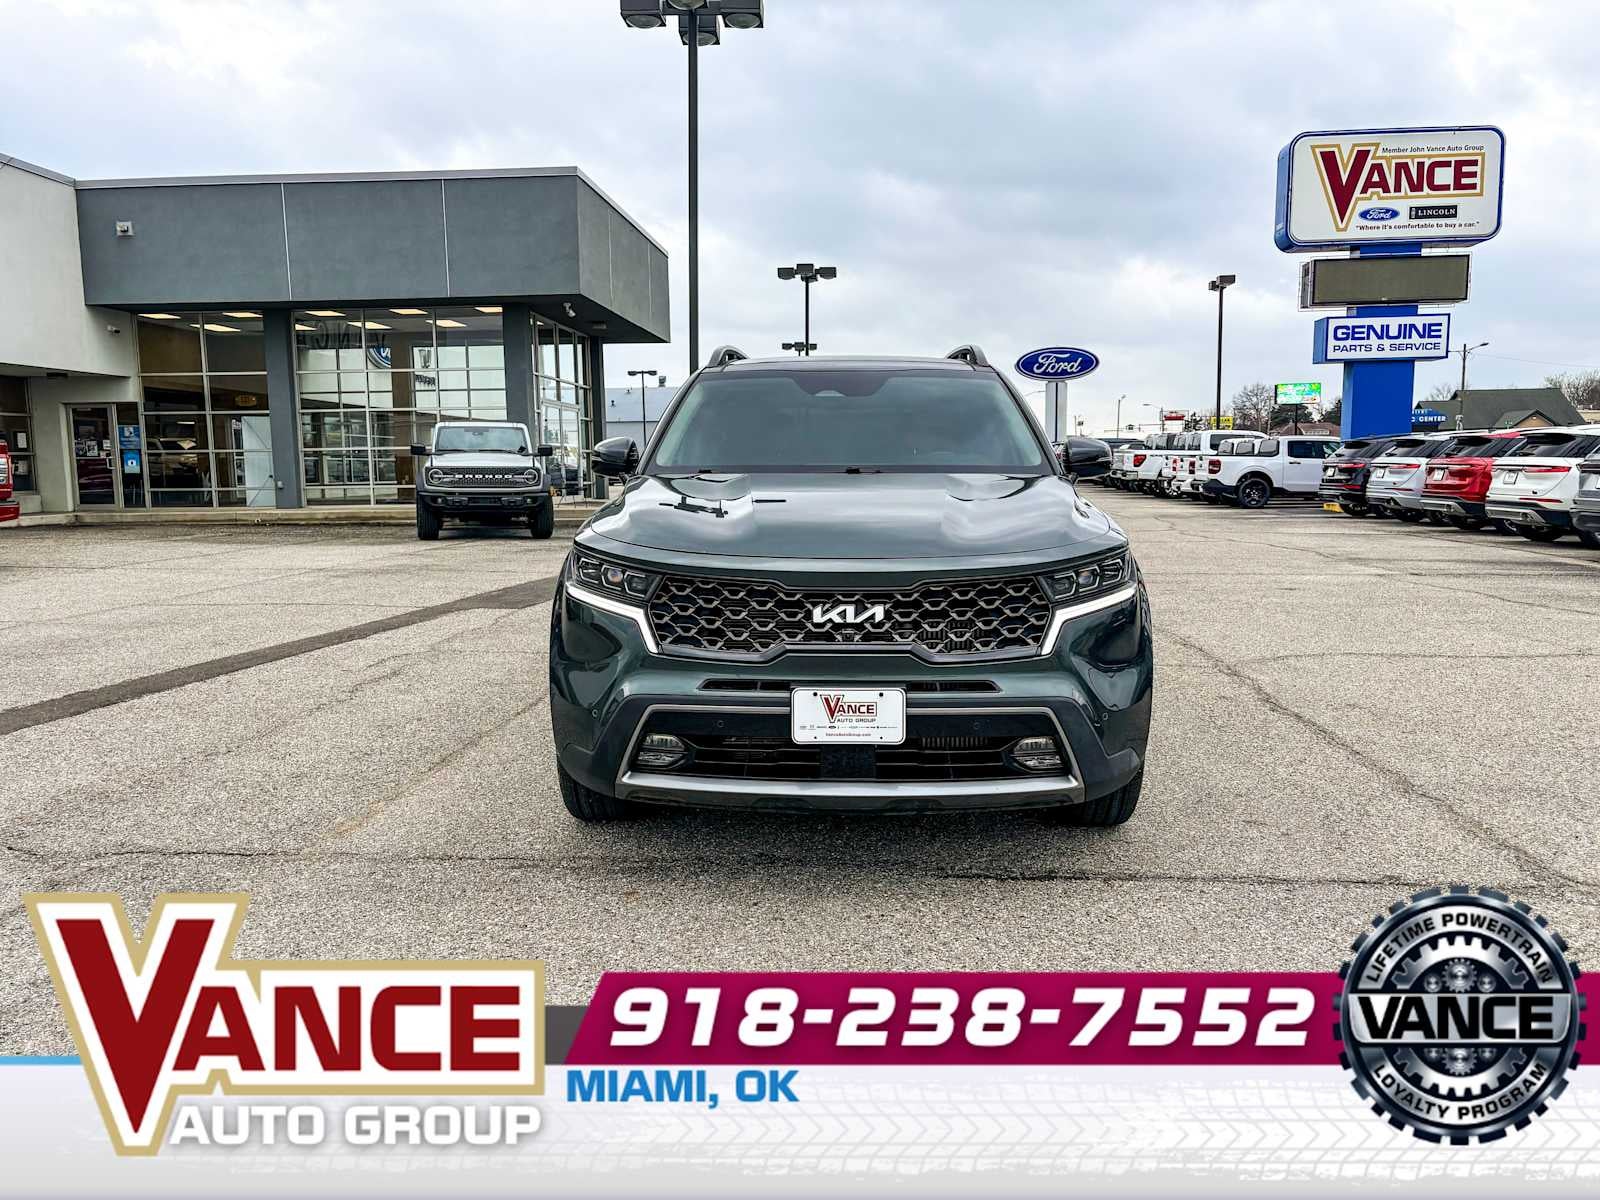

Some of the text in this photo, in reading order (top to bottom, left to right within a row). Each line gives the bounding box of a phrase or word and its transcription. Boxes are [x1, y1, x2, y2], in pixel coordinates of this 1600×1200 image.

[1410, 146, 1425, 154] John
[1464, 144, 1485, 152] Group
[1319, 149, 1479, 224] VANCE
[1366, 209, 1392, 219] Ford
[1418, 208, 1456, 216] LINCOLN
[1393, 222, 1435, 230] comfortable
[1333, 322, 1443, 341] GENUINE
[1333, 342, 1441, 353] PARTS & SERVICE
[1033, 353, 1082, 373] Ford
[1418, 415, 1446, 423] CENTER
[813, 603, 885, 623] KIA
[823, 696, 875, 720] VANCE
